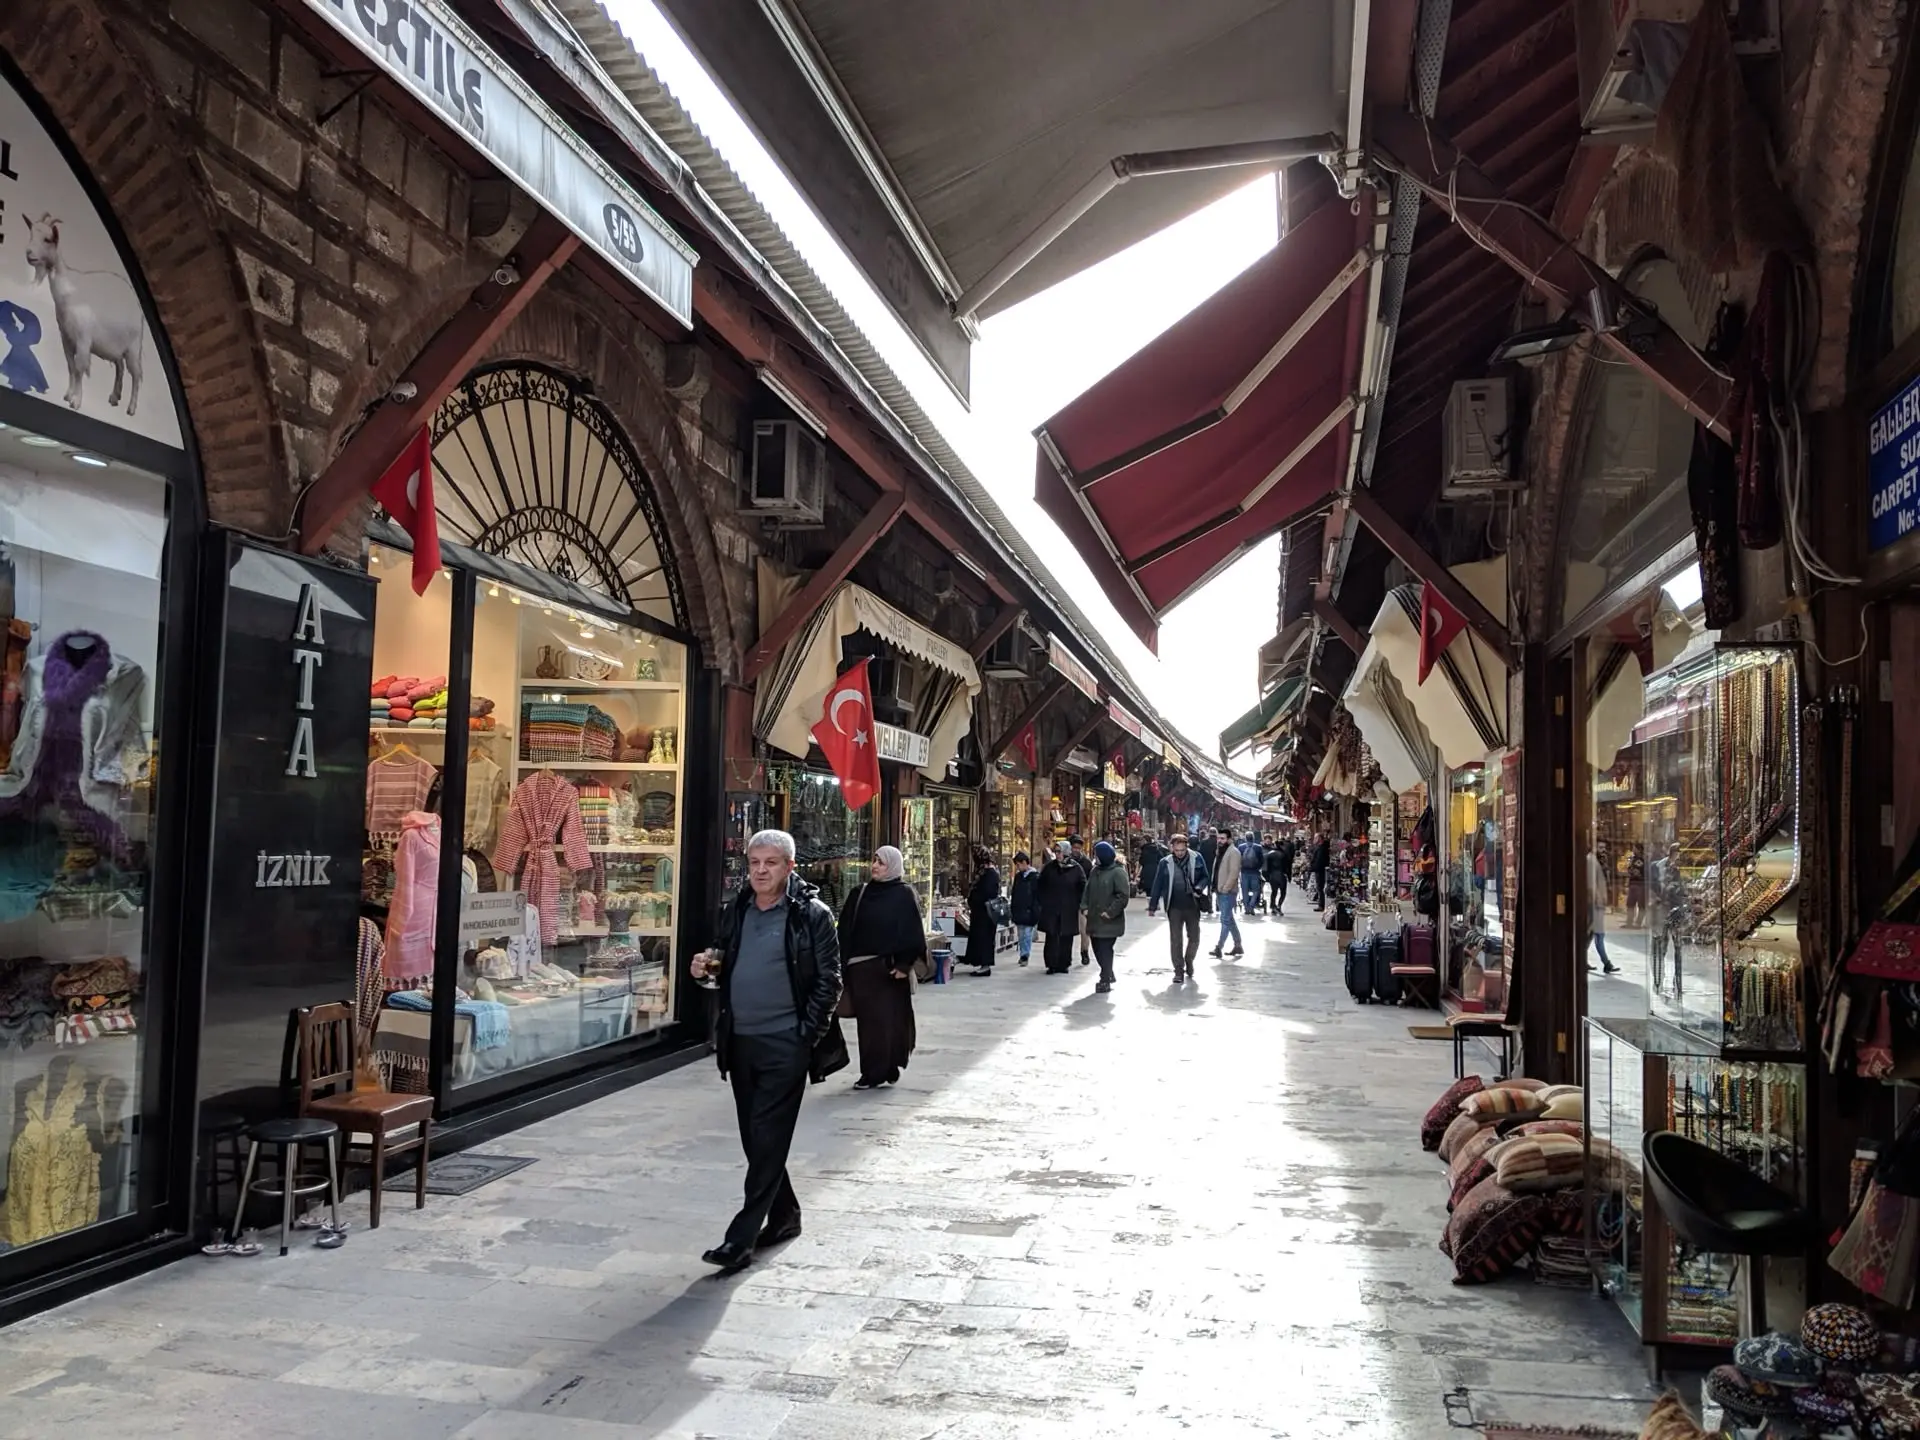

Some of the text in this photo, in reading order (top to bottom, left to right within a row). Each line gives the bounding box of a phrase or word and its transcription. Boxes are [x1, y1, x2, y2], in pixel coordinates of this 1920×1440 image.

[331, 0, 484, 131] EXTILE
[1869, 385, 1920, 456] GALLER
[1872, 466, 1919, 519] CARPET
[286, 583, 325, 778] ATA
[255, 849, 331, 887] İZNİK
